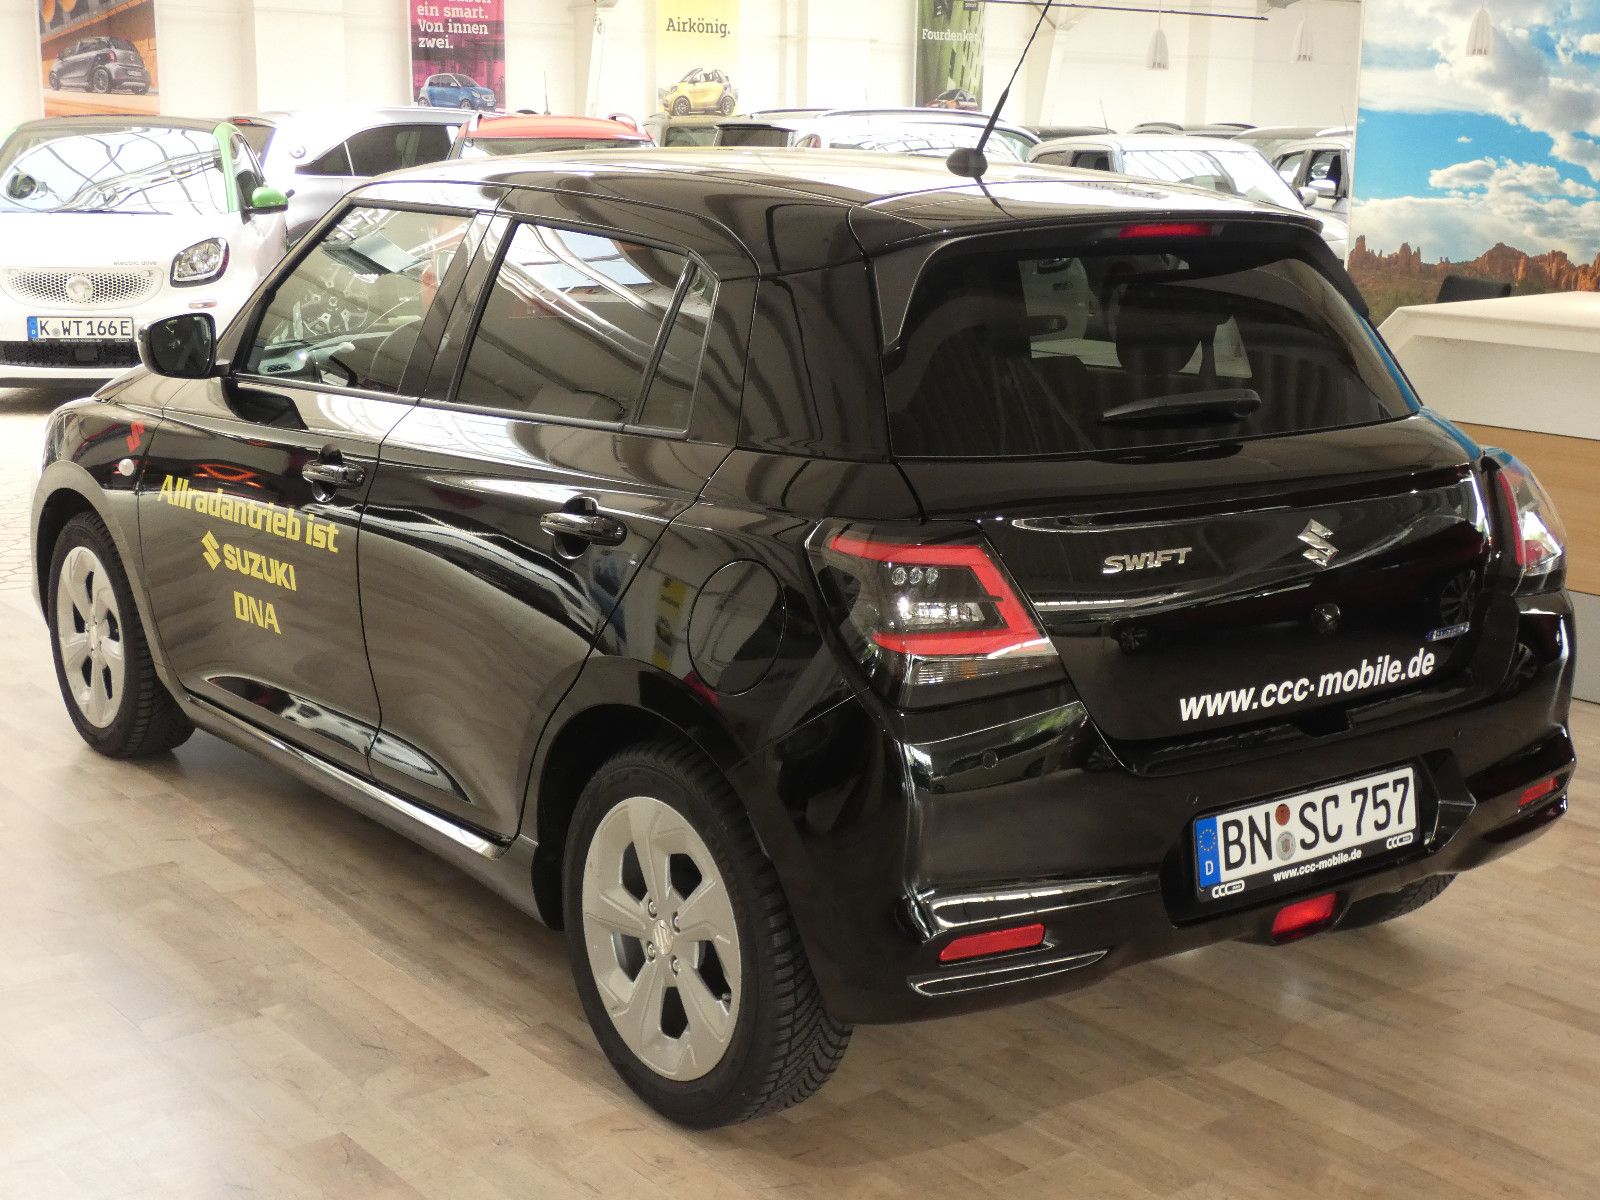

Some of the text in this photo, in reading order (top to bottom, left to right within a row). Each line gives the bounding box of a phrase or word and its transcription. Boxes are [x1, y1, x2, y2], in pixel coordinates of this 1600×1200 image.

[417, 2, 489, 19] ein smart.
[417, 19, 489, 35] Von innen
[665, 16, 731, 38] Airkönig.
[418, 35, 454, 49] zwei.
[39, 320, 50, 336] K
[157, 474, 339, 553] Allradantrieb ist
[222, 543, 297, 591] SUZUKI
[1102, 547, 1193, 574] SWIFT
[233, 590, 282, 635] DNA
[1222, 776, 1410, 872] BN SC 757
[1205, 860, 1214, 876] D
[1273, 848, 1362, 882] www.ccc-mobile.de
